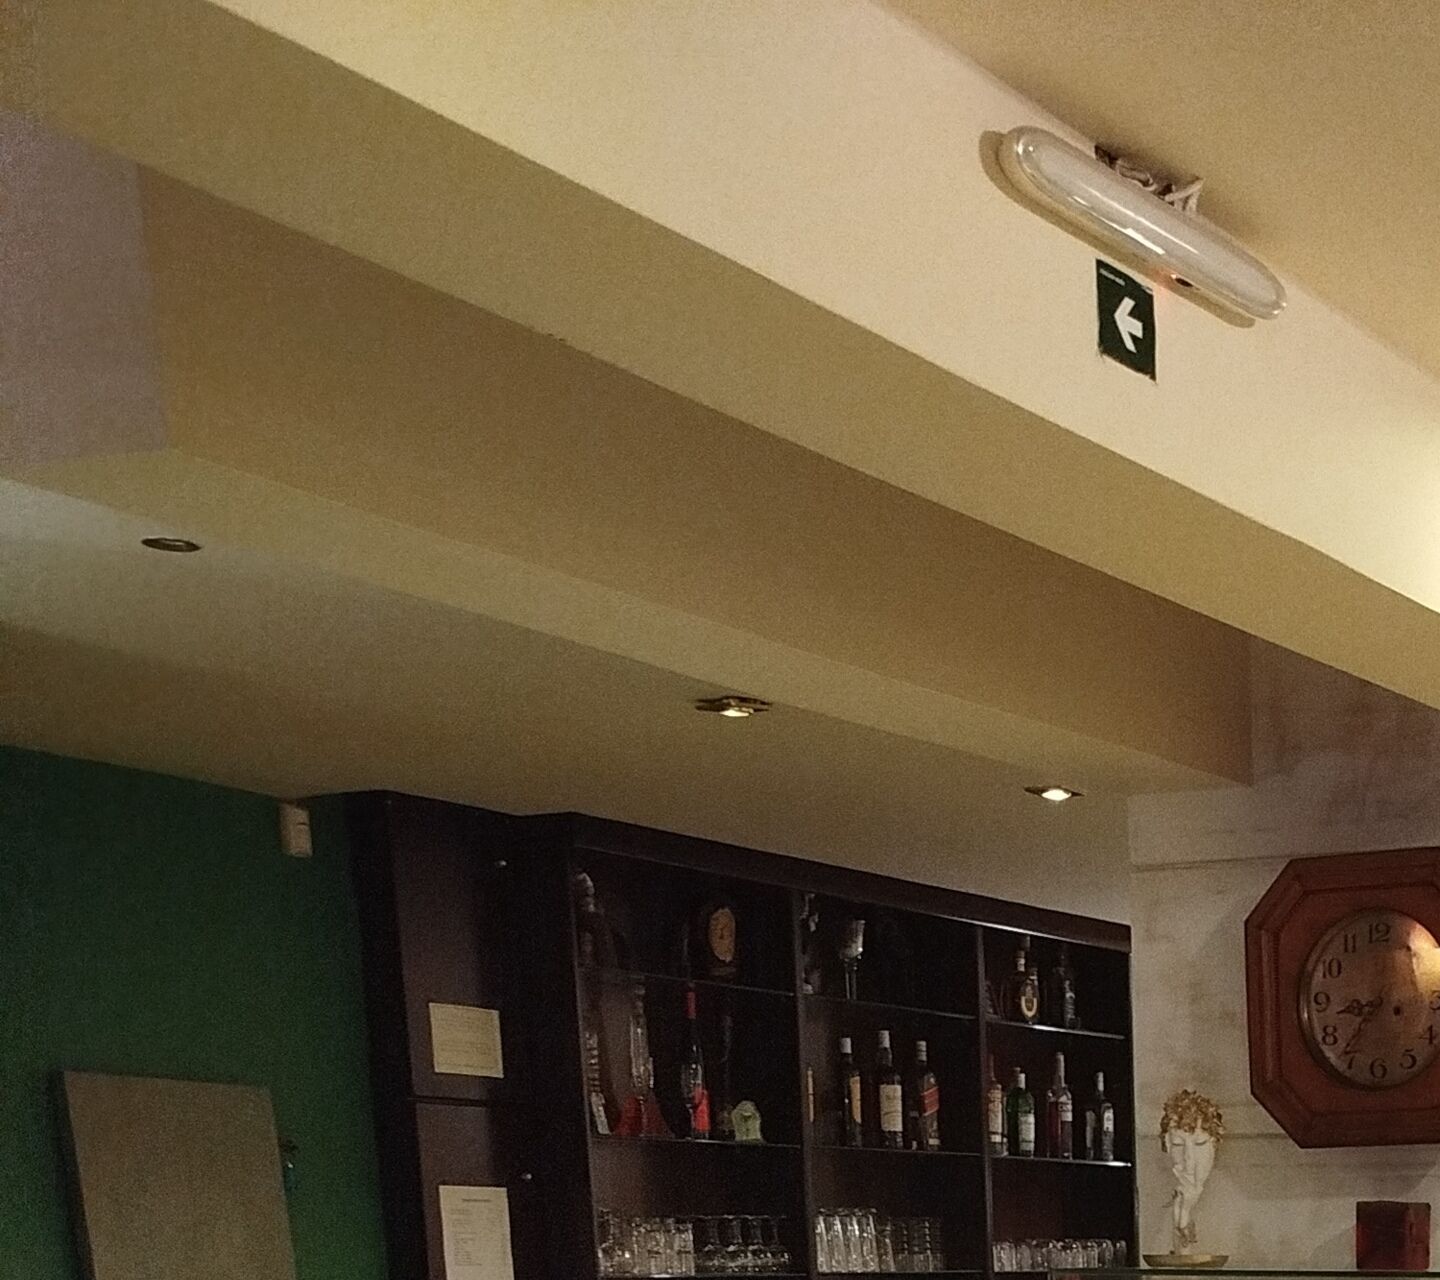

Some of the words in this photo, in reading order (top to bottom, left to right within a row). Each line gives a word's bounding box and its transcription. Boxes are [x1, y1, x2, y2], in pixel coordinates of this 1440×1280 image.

[1344, 934, 1357, 953] 11
[1368, 922, 1391, 944] 12
[1322, 958, 1342, 979] 10
[1313, 991, 1331, 1013] 9
[1322, 1025, 1338, 1046] 8
[1419, 1025, 1437, 1045] 4
[1341, 1049, 1357, 1070] 7
[1369, 1058, 1387, 1080] 6
[1400, 1048, 1417, 1070] 5
